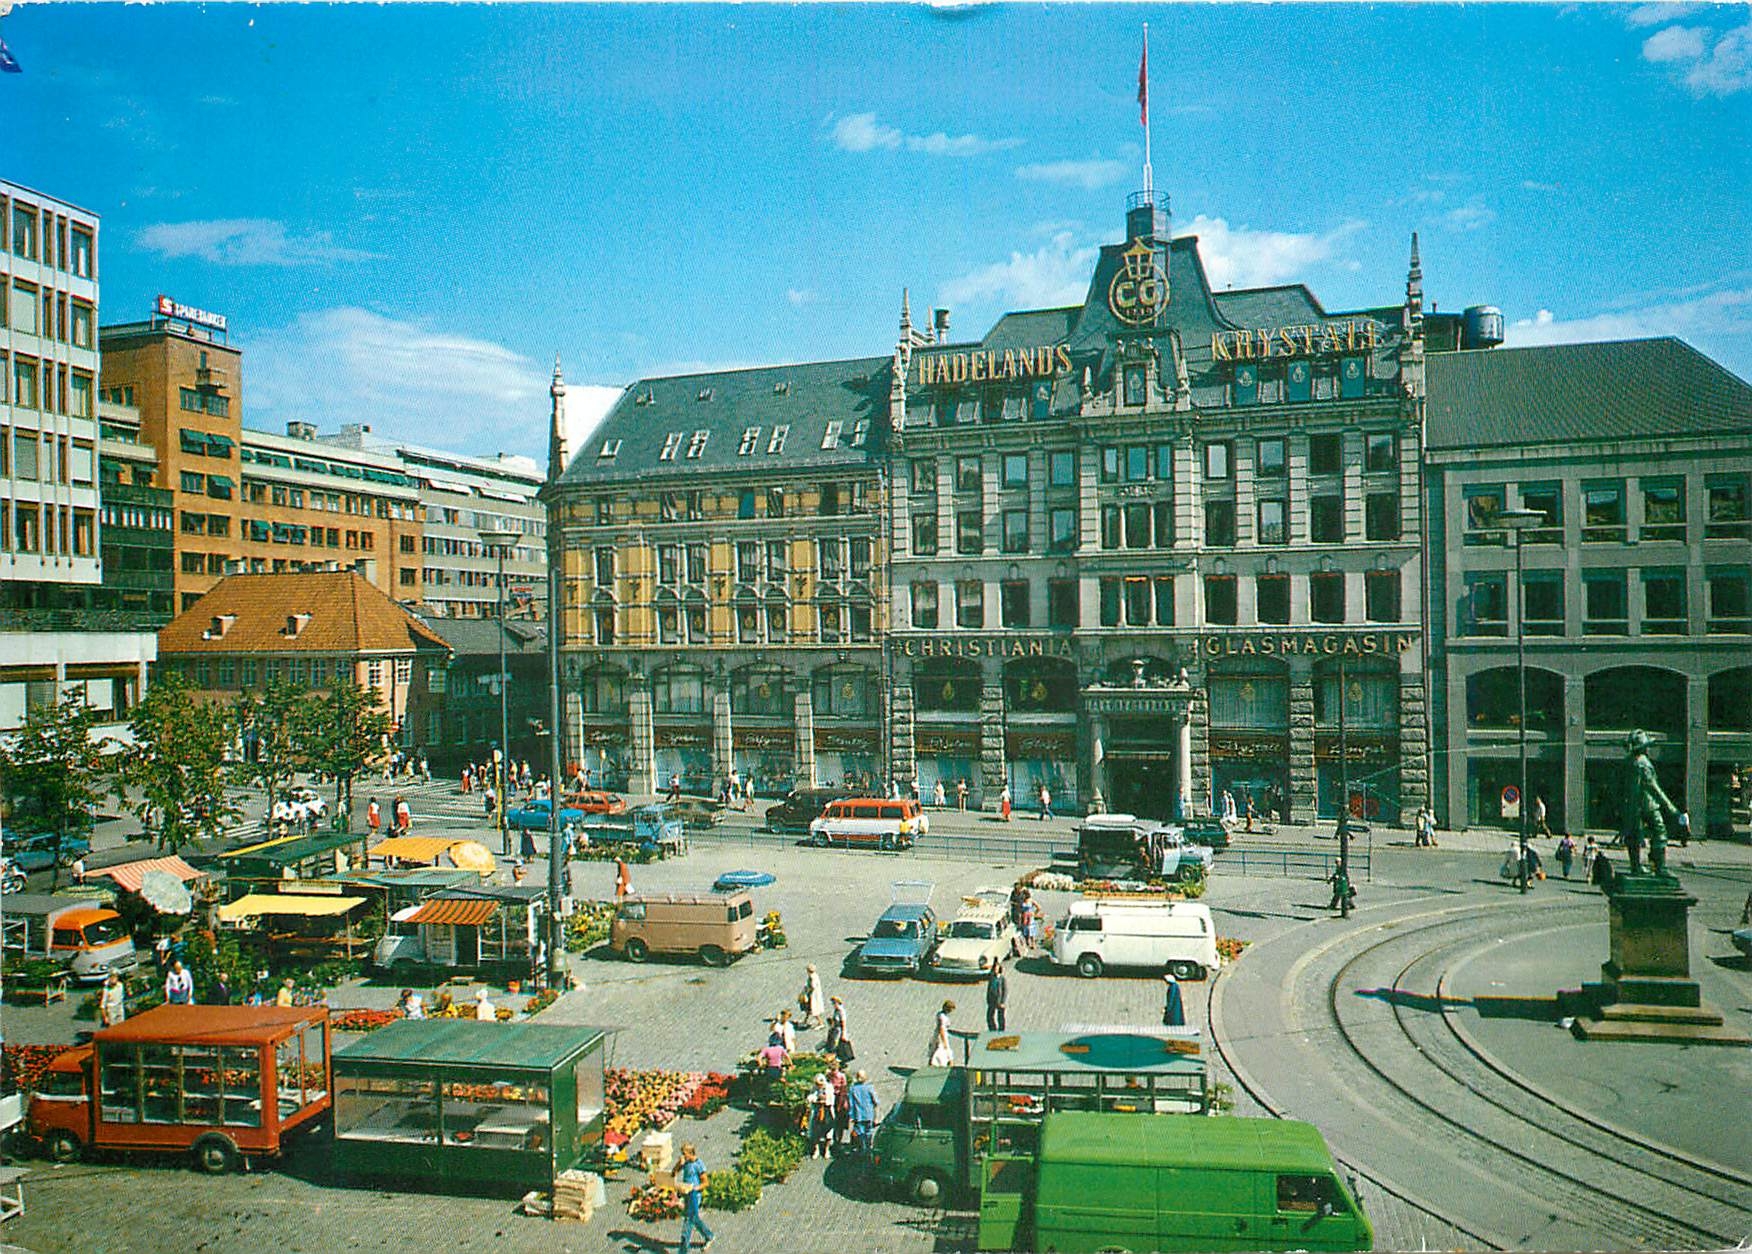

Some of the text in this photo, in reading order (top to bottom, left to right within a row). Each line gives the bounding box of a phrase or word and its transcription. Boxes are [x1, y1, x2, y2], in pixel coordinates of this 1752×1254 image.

[919, 320, 1379, 385] HADELANDS KRYSTALL
[905, 634, 1412, 656] CHRISTIANIA GLASMAGASIN
